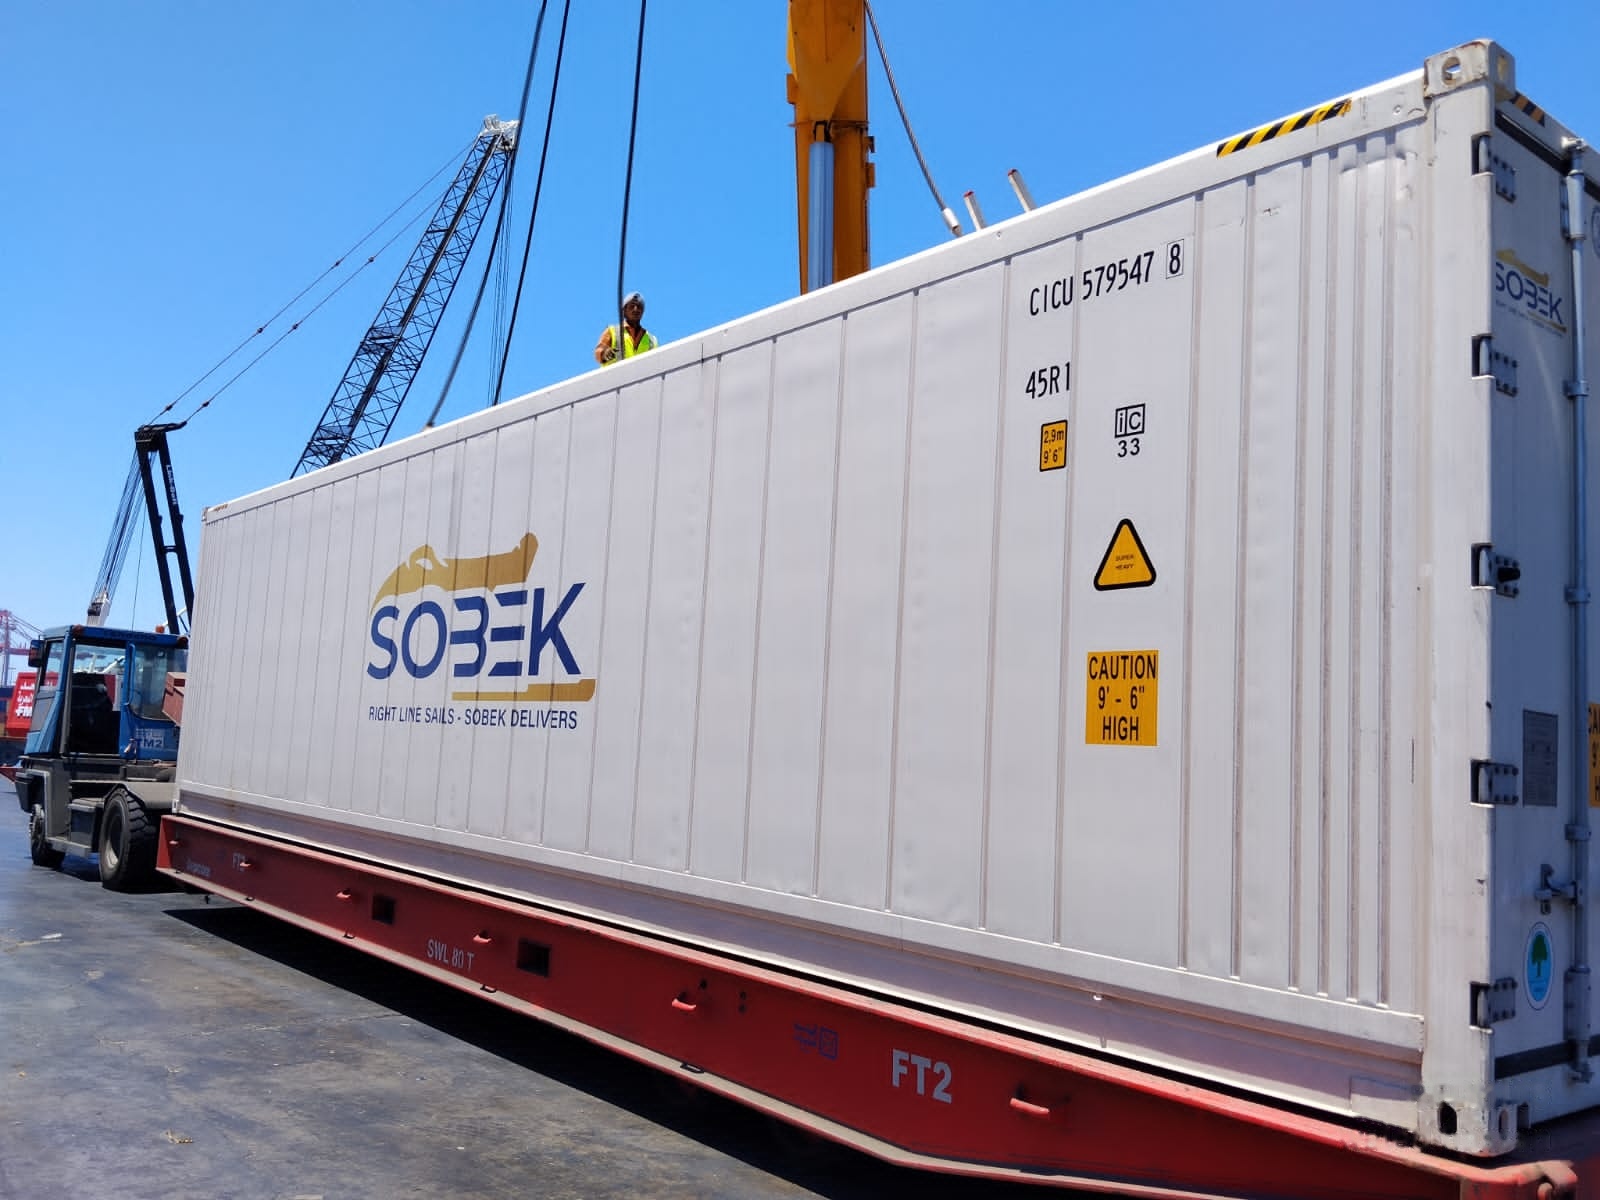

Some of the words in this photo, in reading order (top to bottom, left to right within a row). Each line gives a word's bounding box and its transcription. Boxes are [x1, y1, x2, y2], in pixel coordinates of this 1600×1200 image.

[1030, 276, 1074, 316] CICU
[1082, 251, 1154, 300] 579547
[1169, 244, 1181, 274] 8
[1026, 362, 1070, 399] 45R1
[1117, 438, 1140, 457] 33
[367, 582, 586, 680] SOBEK
[1088, 654, 1157, 681] CAUTION
[369, 706, 397, 721] RIGHT
[400, 706, 421, 723] LINE
[424, 707, 454, 725] SAILS
[465, 708, 506, 727] SOBEK
[511, 709, 577, 730] DELIVERS
[1102, 716, 1140, 742] HIGH
[427, 939, 448, 964] SWL
[452, 948, 464, 969] 80
[892, 1049, 952, 1104] FT2
